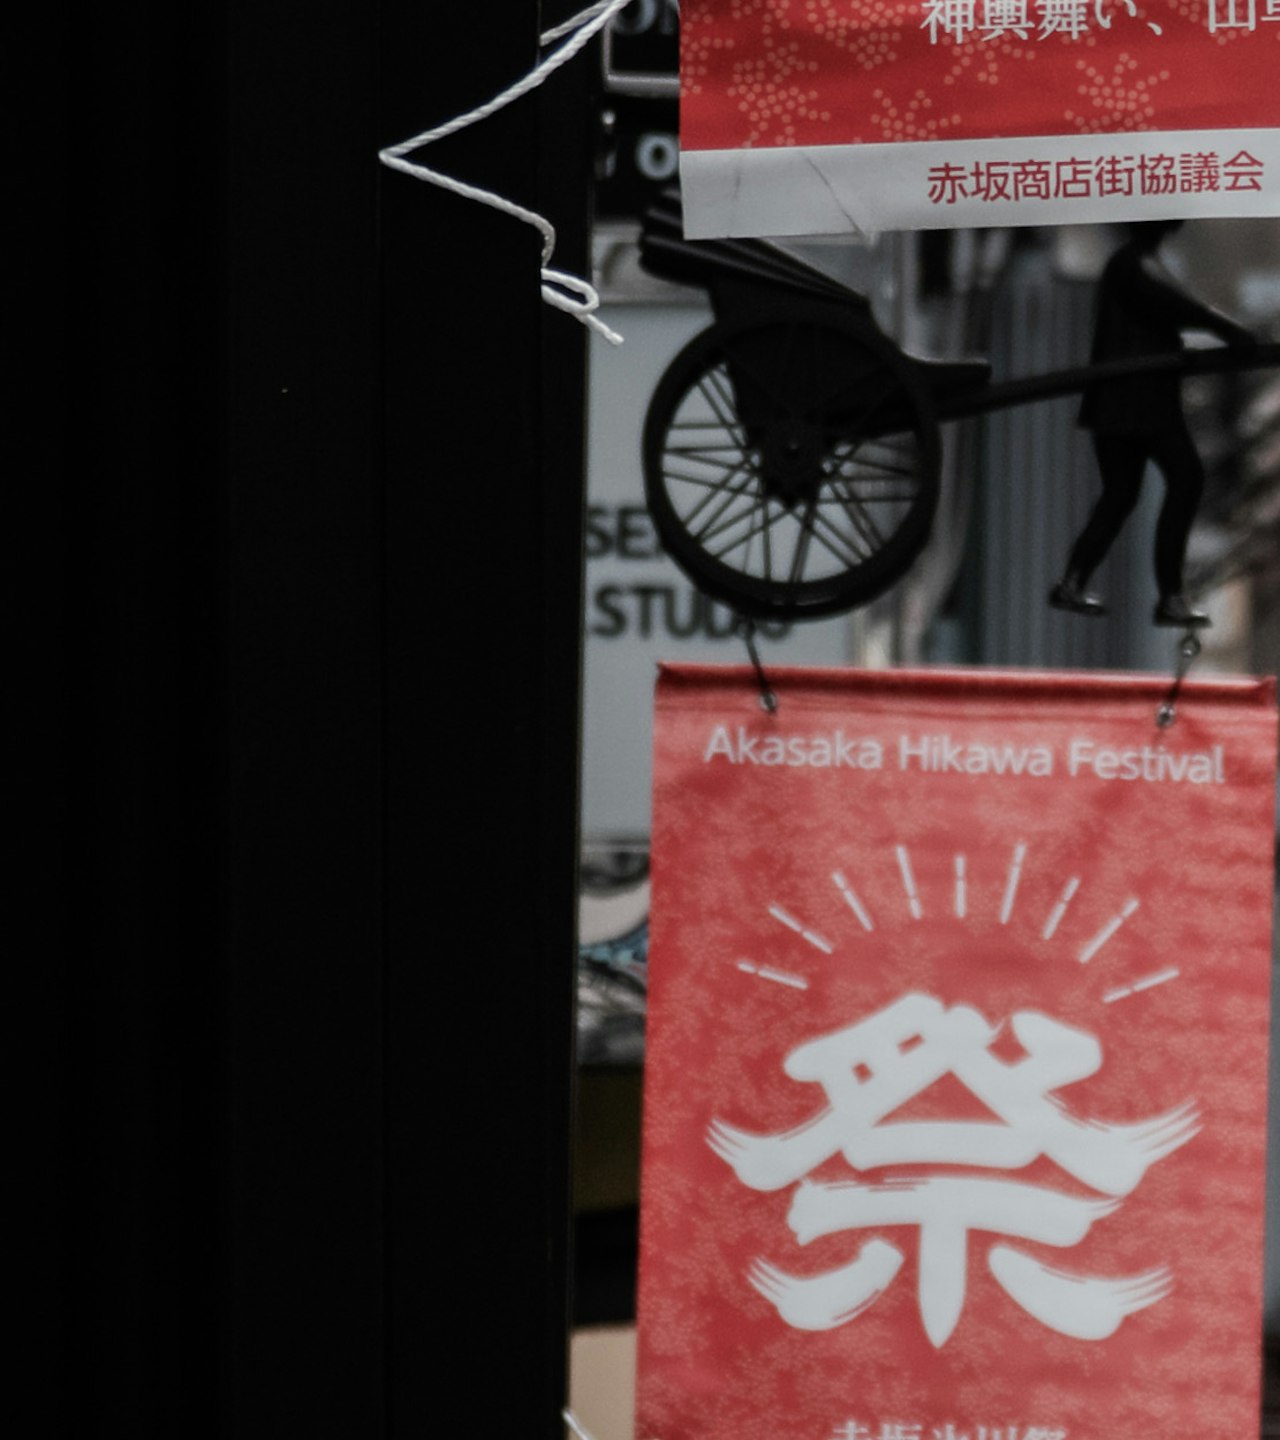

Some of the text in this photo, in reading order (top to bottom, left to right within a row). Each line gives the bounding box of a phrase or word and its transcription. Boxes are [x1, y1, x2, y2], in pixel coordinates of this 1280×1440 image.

[926, 150, 1264, 204] 赤坂商店街協議会
[704, 726, 1224, 784] Akasaka Hikawa Festival
[705, 992, 1203, 1349] 祭
